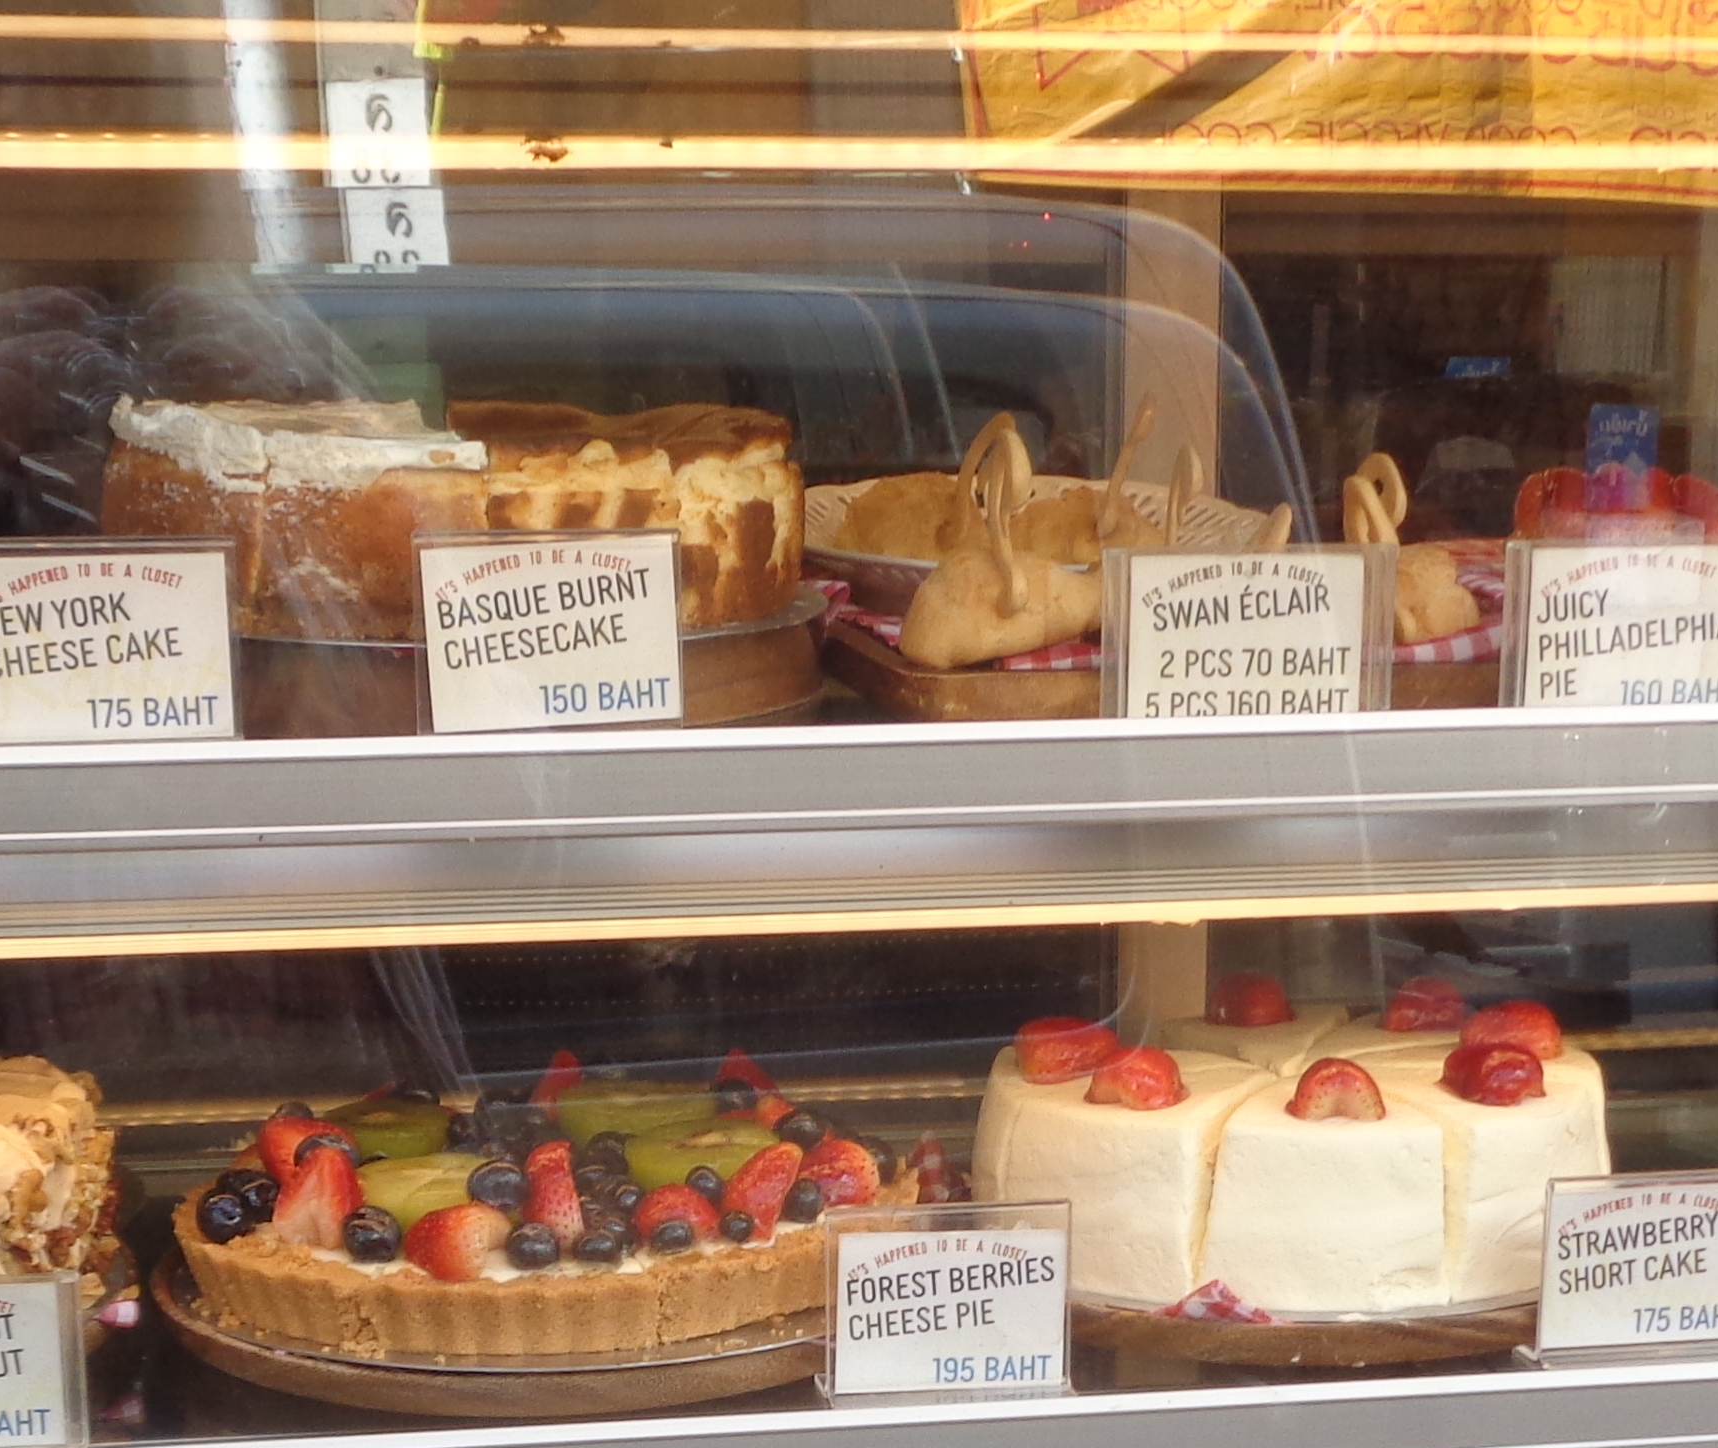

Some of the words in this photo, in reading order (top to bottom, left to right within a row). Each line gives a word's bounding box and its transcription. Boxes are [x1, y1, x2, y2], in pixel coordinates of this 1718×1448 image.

[51, 592, 131, 629] YORK
[437, 584, 550, 629] BASQUE
[558, 568, 649, 610] BURNT
[1153, 595, 1229, 632] SWAN
[1241, 584, 1330, 621] ÉCLAIR
[1537, 589, 1608, 624] JUICY
[106, 627, 182, 664] CAKE
[444, 614, 627, 670] CHEESECAKE
[1160, 651, 1174, 678] 2
[1185, 650, 1232, 678] PCS
[1242, 648, 1271, 677] 70
[1283, 648, 1351, 676] BAHT
[539, 684, 587, 714] 150
[599, 678, 670, 710] BAHT
[1541, 669, 1577, 699] PIE
[1621, 680, 1661, 705] 160
[87, 699, 132, 728] 175
[144, 696, 217, 726] BAHT
[1145, 692, 1159, 718] 5
[1171, 691, 1217, 717] PCS
[1227, 690, 1270, 716] 160
[1282, 689, 1349, 714] BAHT
[1558, 1211, 1718, 1260] STRAWBERRY
[846, 1270, 940, 1306] FOREST
[950, 1256, 1054, 1294] BERRIES
[1559, 1259, 1637, 1294] SHORT
[1644, 1248, 1707, 1281] CAKE
[849, 1305, 947, 1340] CHEESE
[957, 1299, 995, 1329] PIE
[1634, 1307, 1670, 1333] 175
[933, 1358, 974, 1383] 195
[985, 1355, 1051, 1381] BAHT
